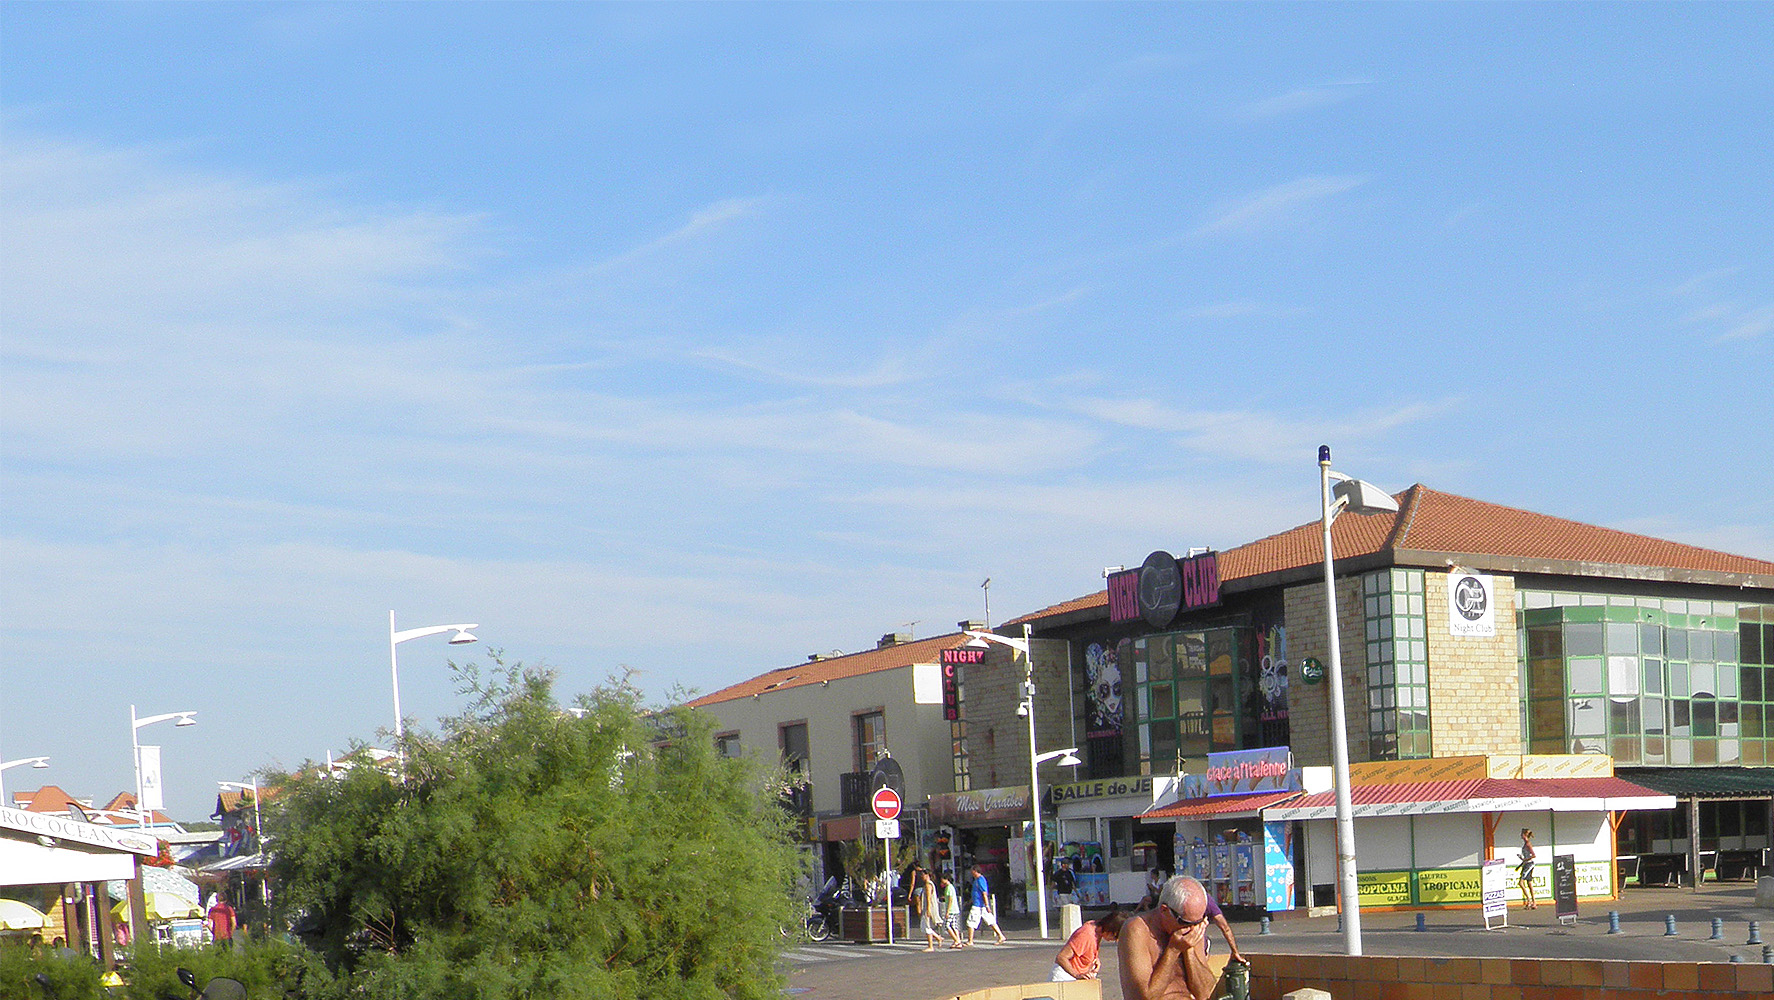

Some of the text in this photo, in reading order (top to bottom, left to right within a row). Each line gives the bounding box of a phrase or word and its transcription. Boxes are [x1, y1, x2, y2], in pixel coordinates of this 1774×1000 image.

[1108, 556, 1219, 622] NIGHT CLUB
[1454, 623, 1493, 633] Night Club
[943, 650, 984, 663] NIGHT
[945, 665, 957, 720] CLUB
[1053, 777, 1151, 801] SALLE de JE
[1423, 880, 1480, 891] TROPICANA
